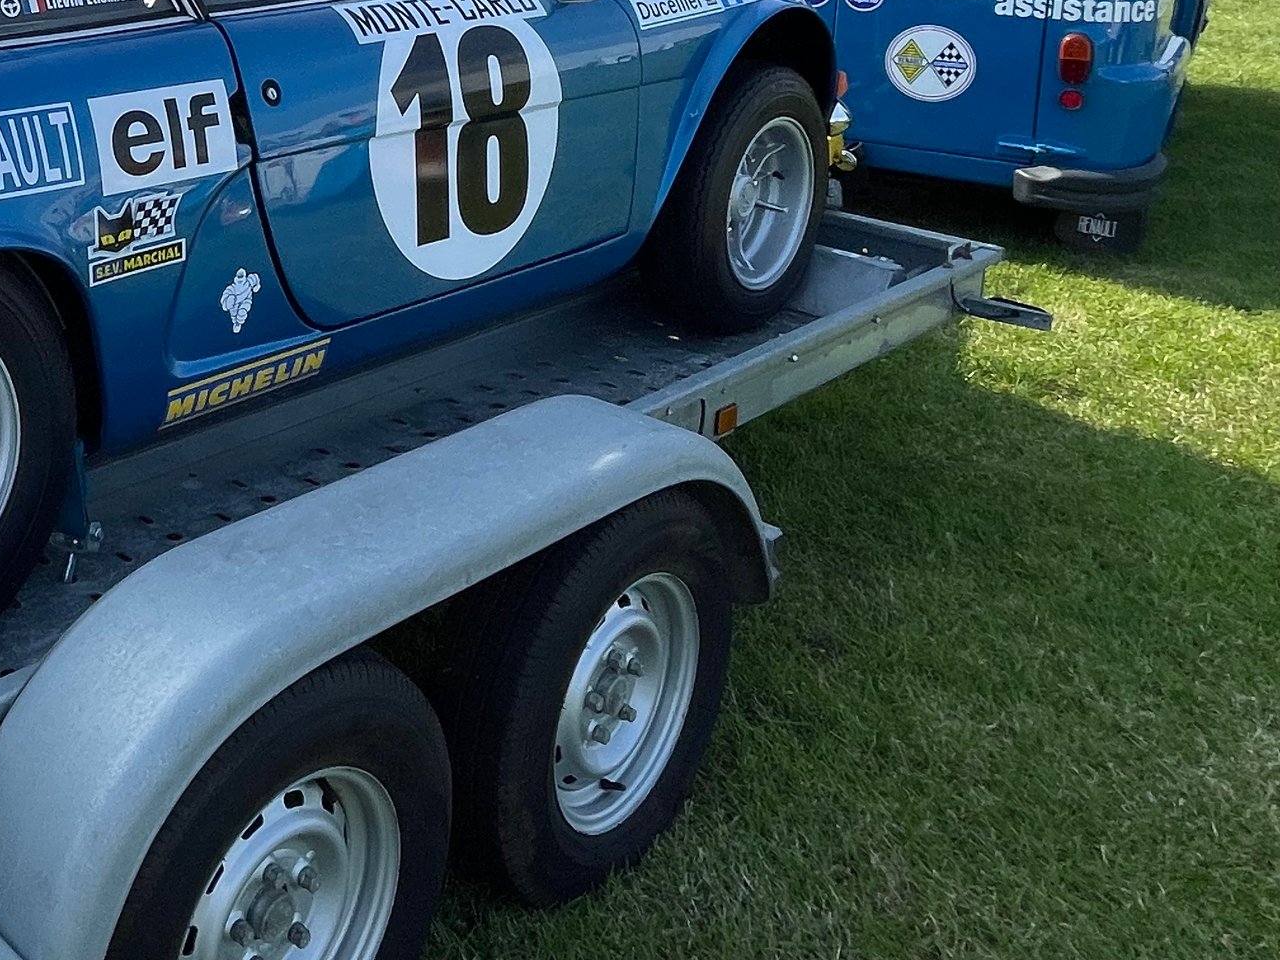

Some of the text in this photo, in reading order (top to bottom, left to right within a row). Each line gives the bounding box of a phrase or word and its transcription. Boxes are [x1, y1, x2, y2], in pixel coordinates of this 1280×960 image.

[111, 93, 222, 180] elf
[390, 24, 531, 247] 18
[124, 245, 181, 271] MARCHAL
[165, 349, 326, 423] MICHELIN
